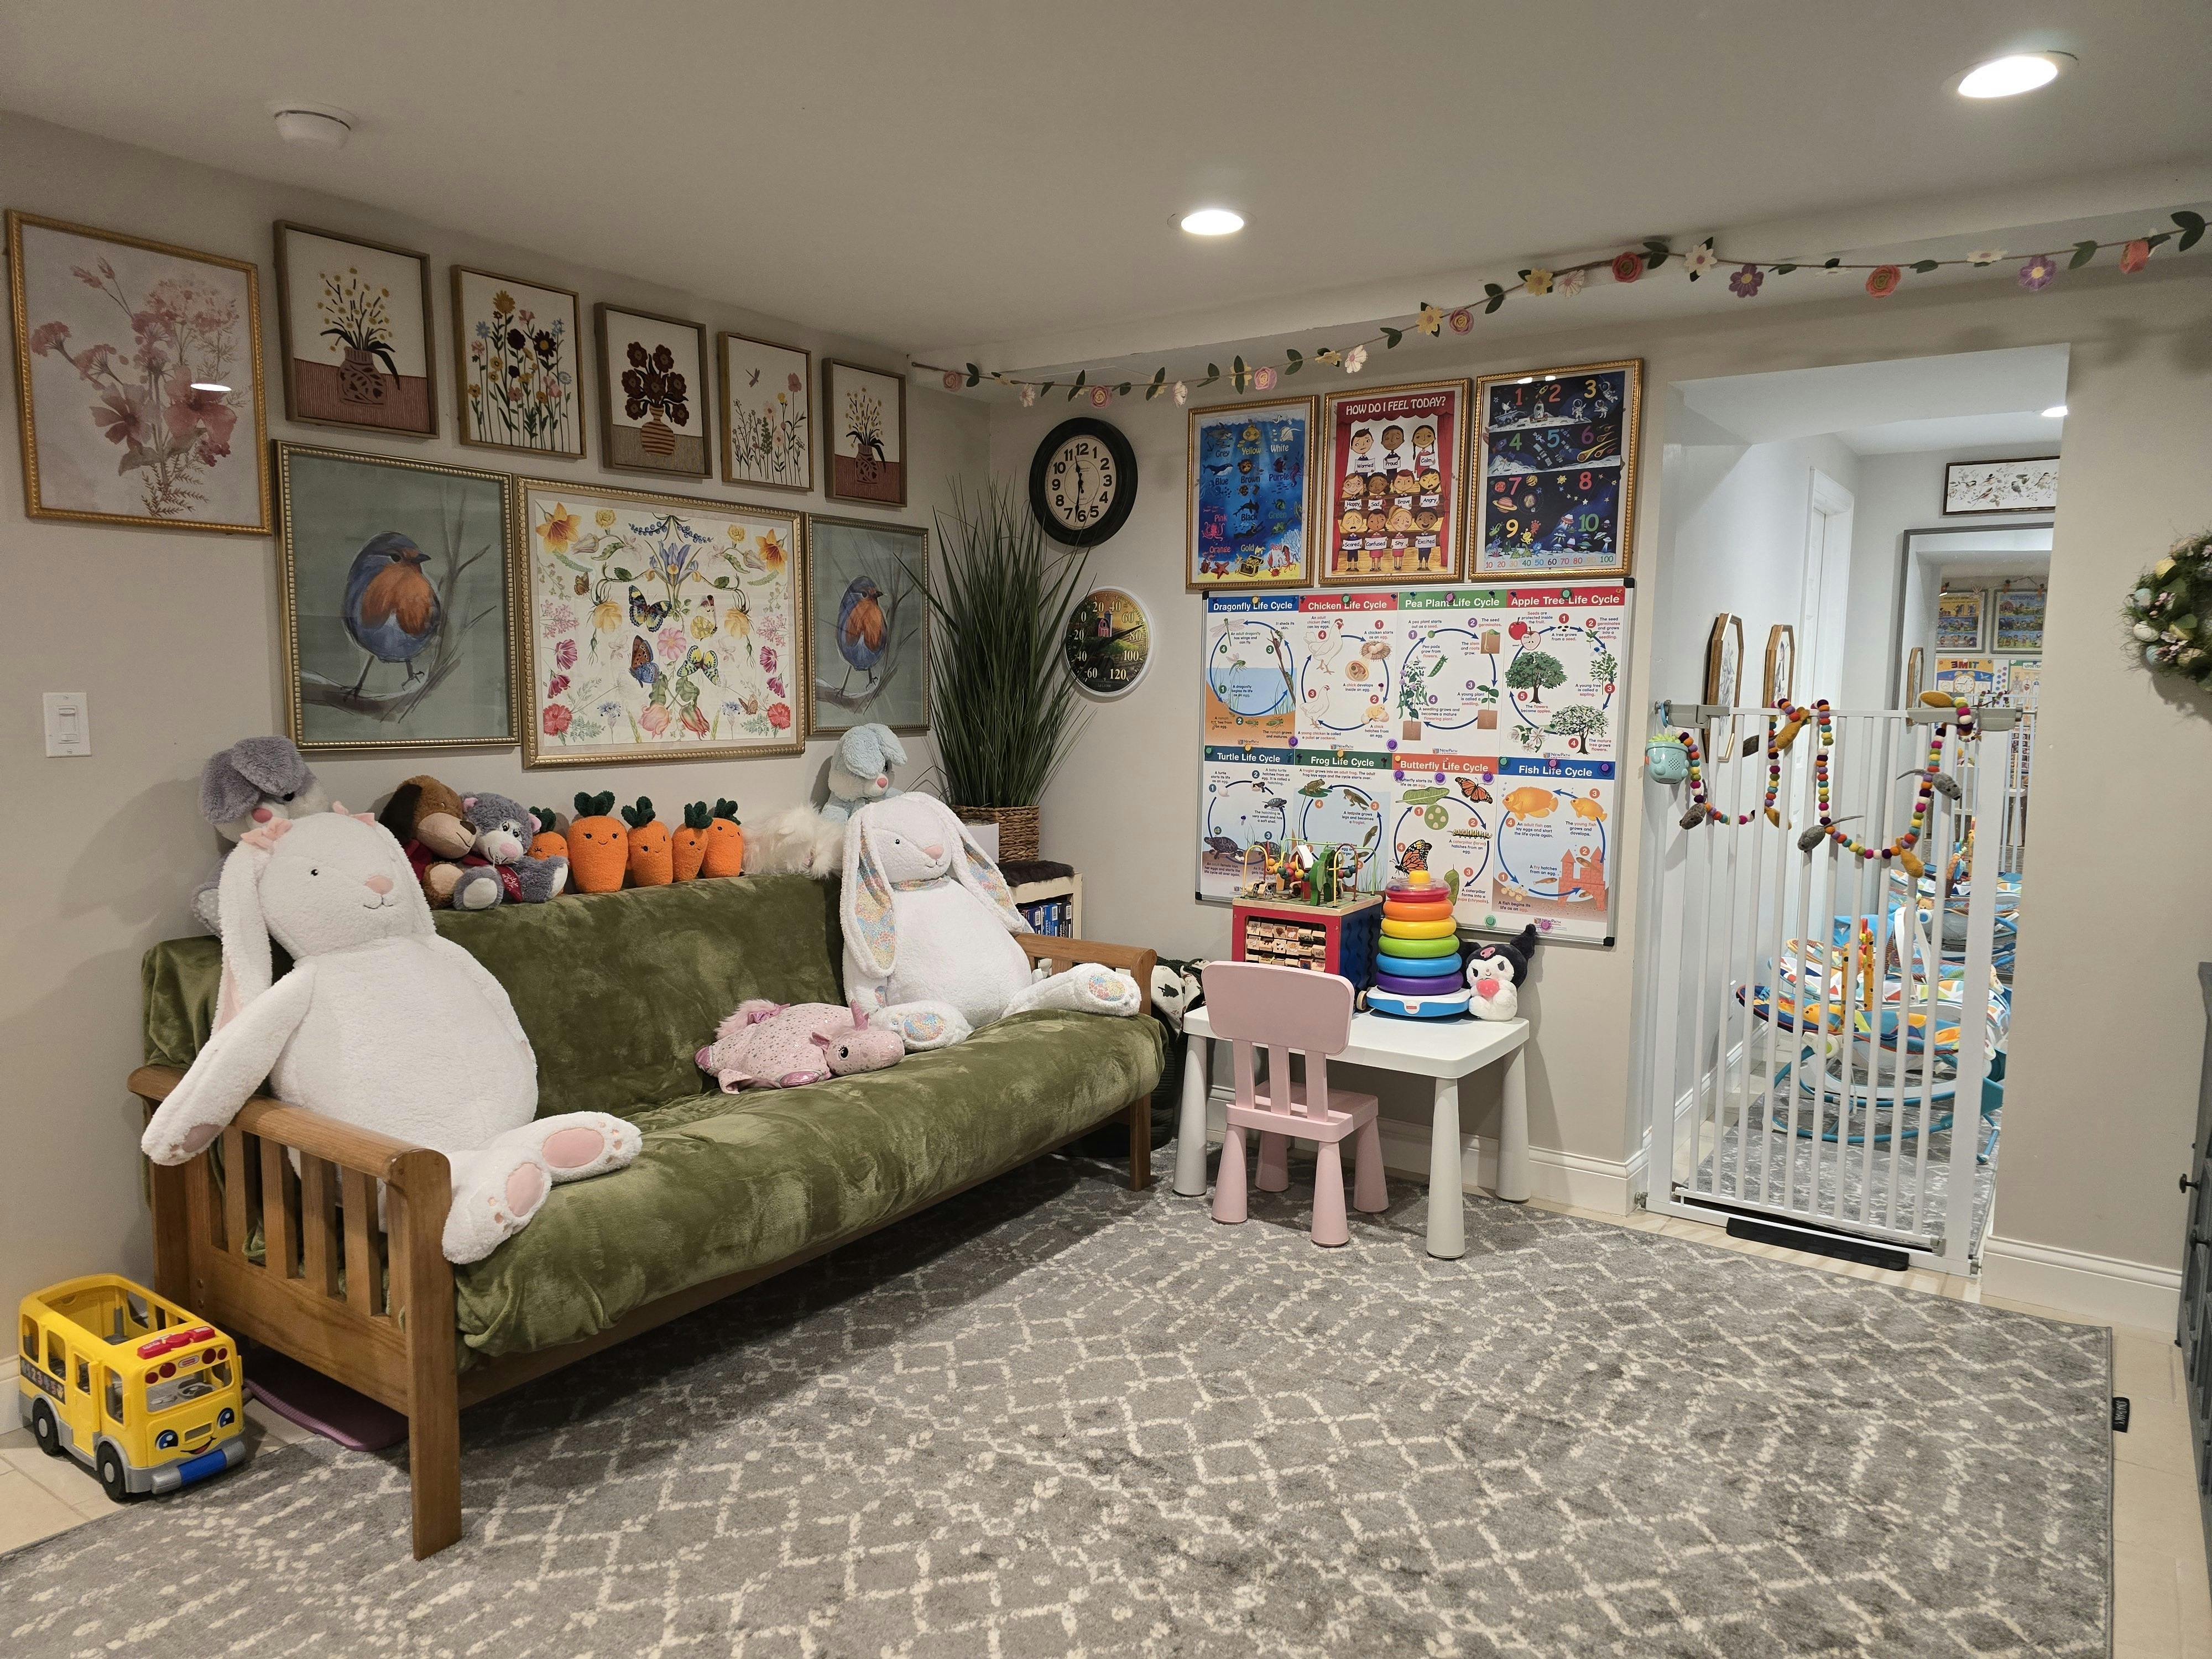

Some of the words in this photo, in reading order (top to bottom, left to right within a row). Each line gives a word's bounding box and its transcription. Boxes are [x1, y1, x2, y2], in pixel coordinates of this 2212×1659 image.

[1515, 388, 1522, 405] 1
[1549, 384, 1561, 402] 2
[1584, 379, 1597, 398] 3
[1346, 404, 1366, 415] HOW
[1369, 403, 1381, 413] DO
[1383, 401, 1386, 411] I
[1388, 400, 1408, 411] FEEL
[1411, 397, 1446, 409] TODAY?
[1509, 433, 1522, 450] 4
[1547, 430, 1560, 447] 5
[1582, 426, 1594, 444] 6
[1076, 443, 1089, 455] 12
[1093, 446, 1097, 458] 1
[1271, 444, 1288, 452] White
[1064, 448, 1074, 461] 11
[1053, 462, 1066, 474] 10
[1100, 458, 1109, 470] 2
[1103, 474, 1112, 487] 3
[1269, 473, 1289, 482] Purple
[1509, 477, 1522, 495] 7
[1579, 472, 1592, 490] 8
[1052, 479, 1061, 491] 9
[1056, 495, 1064, 507] 8
[1099, 491, 1108, 503] 4
[1064, 508, 1073, 520] 7
[1077, 510, 1086, 522] 6
[1090, 505, 1099, 518] 5
[1506, 519, 1519, 538] 9
[1578, 514, 1599, 532] 10
[1093, 602, 1104, 612] 20
[1109, 601, 1121, 612] 40
[1213, 602, 1251, 611] Dragonfly
[1271, 602, 1292, 611] Cycle
[1364, 601, 1387, 610] Cycle
[1474, 598, 1499, 608] Cycle
[1511, 597, 1540, 607] Apple
[1569, 596, 1588, 604] Life
[1592, 595, 1619, 606] Cycle
[1081, 611, 1086, 622] 0
[1121, 612, 1134, 623] 60
[1129, 630, 1141, 641] 80
[1124, 650, 1139, 661] 100
[1110, 669, 1126, 680] 120
[1259, 755, 1280, 763] Cycle
[1311, 757, 1329, 765] Frog
[1351, 758, 1374, 767] Cycle
[1401, 761, 1439, 770] Butterfly
[1443, 762, 1459, 770] Life
[1463, 763, 1488, 772] Cycle
[1519, 765, 1539, 774] Fish
[1543, 766, 1561, 775] Life
[1565, 768, 1592, 777] Cycle
